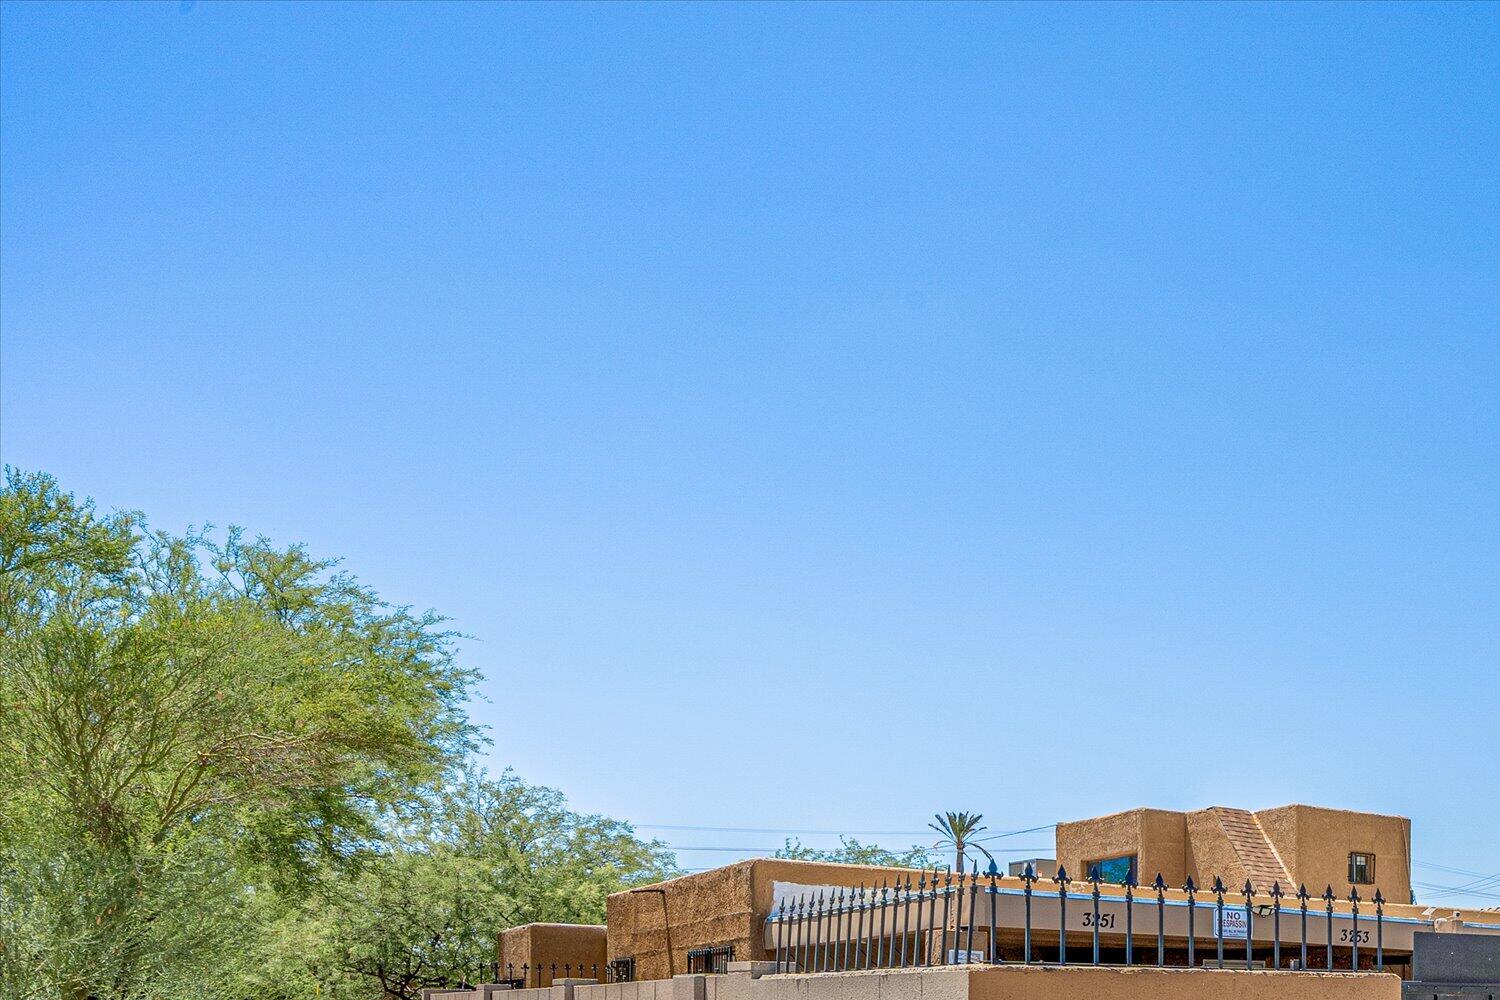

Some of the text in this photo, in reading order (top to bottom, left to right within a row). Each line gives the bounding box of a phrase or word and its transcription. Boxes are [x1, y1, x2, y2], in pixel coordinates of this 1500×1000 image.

[1082, 912, 1115, 928] 3251
[1226, 911, 1241, 920] NO
[1340, 929, 1370, 943] 3253
